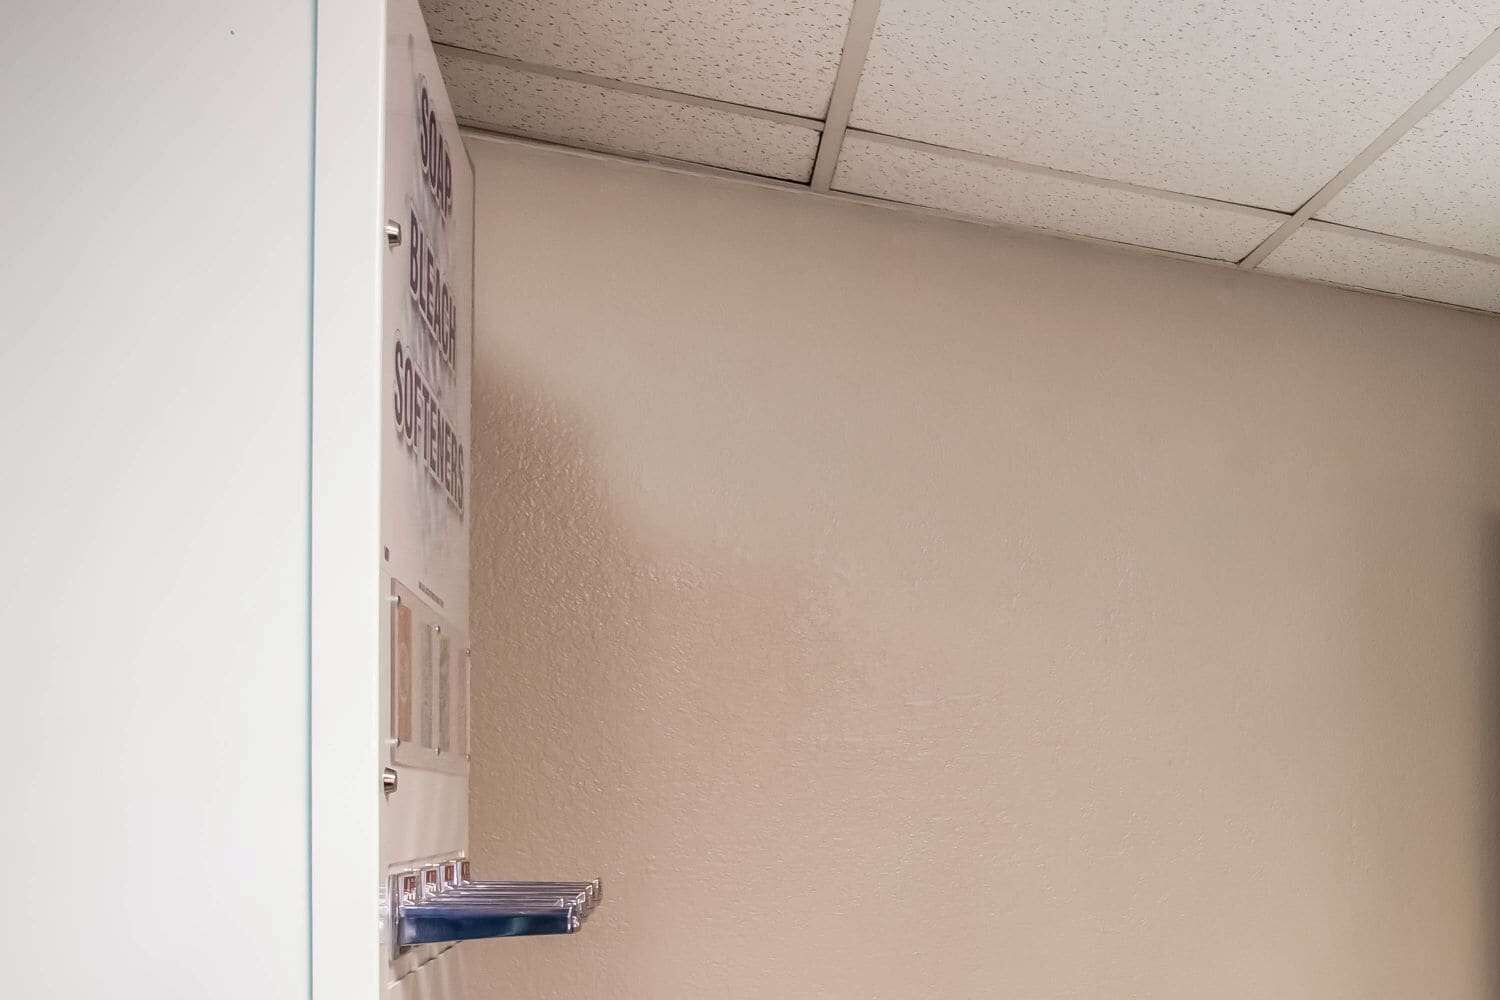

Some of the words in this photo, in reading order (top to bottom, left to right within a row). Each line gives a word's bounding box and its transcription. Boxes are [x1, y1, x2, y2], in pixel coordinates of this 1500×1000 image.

[420, 86, 453, 223] SOAP
[409, 203, 457, 372] BLEACH
[393, 339, 465, 519] SOFTENERS
